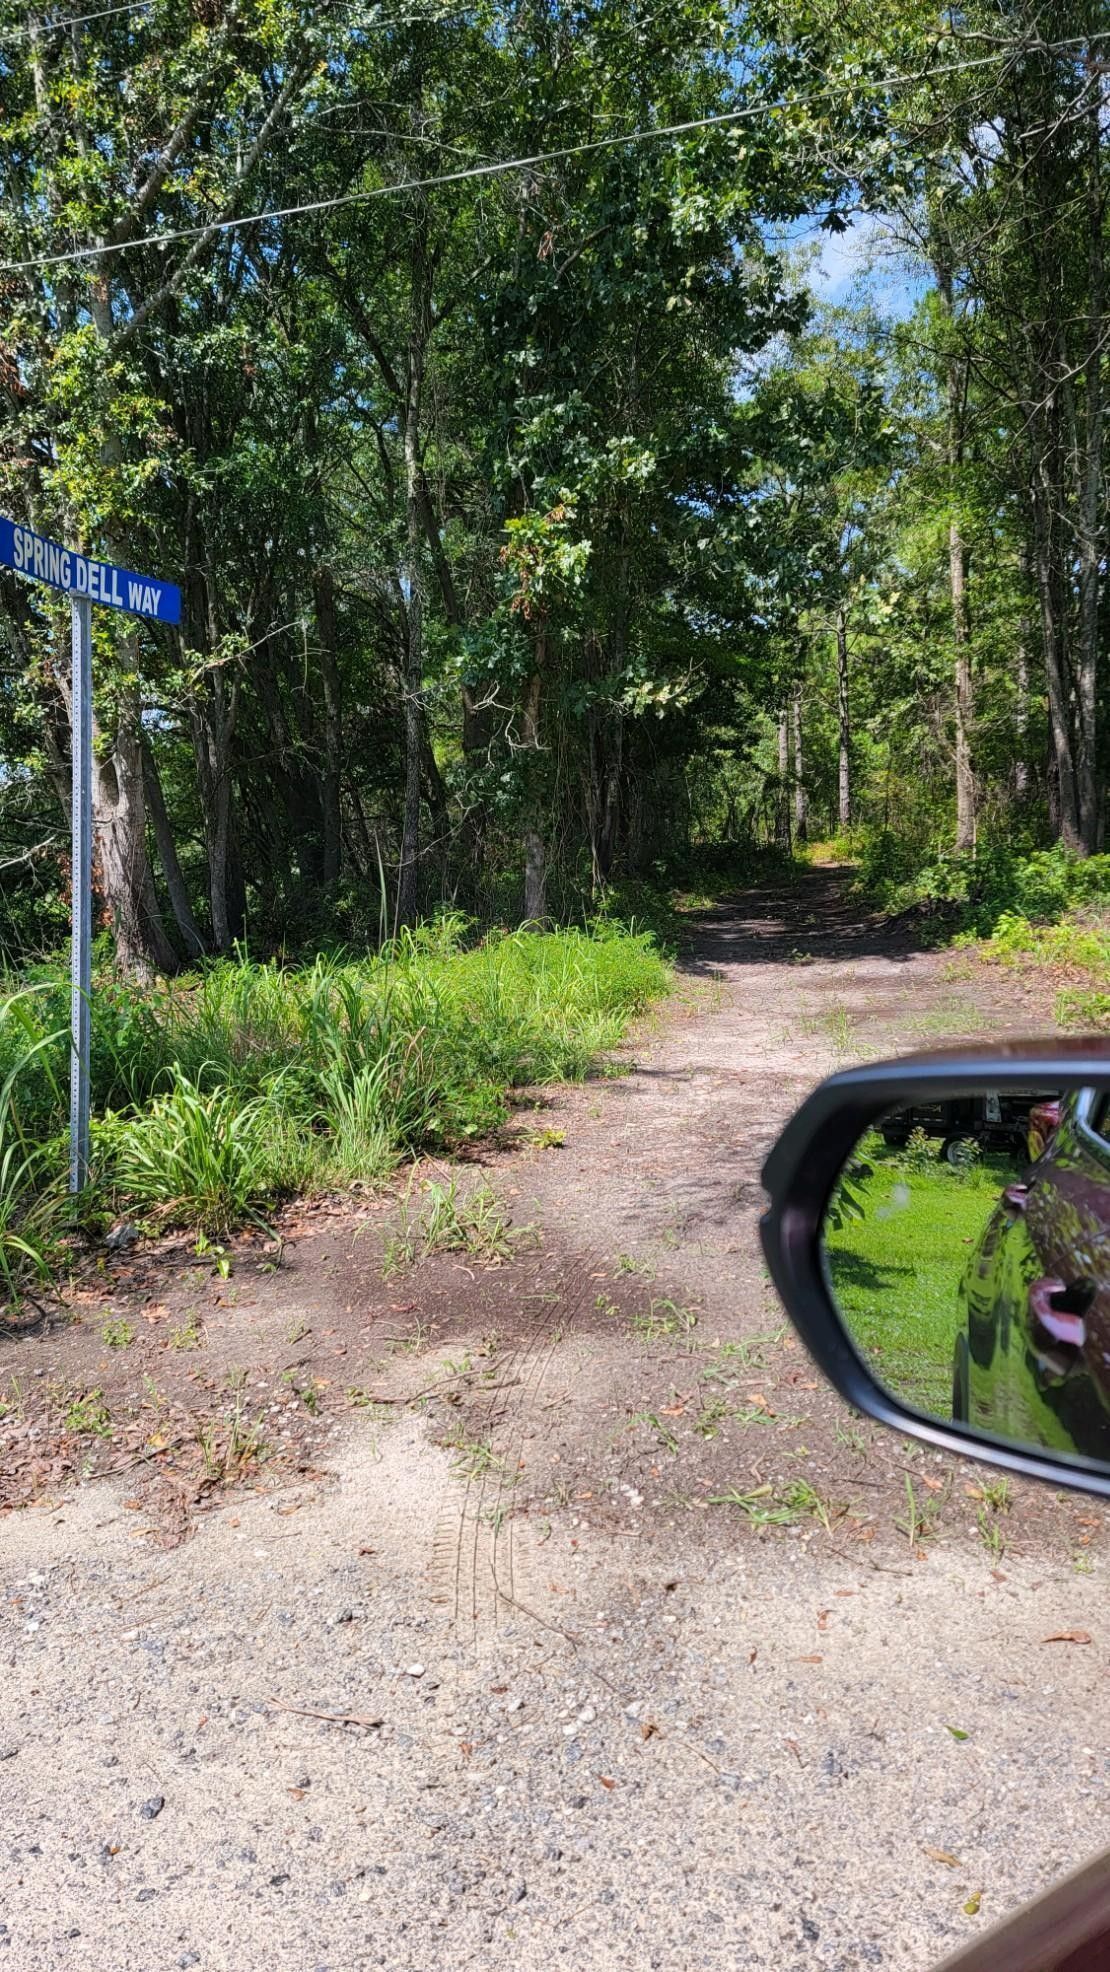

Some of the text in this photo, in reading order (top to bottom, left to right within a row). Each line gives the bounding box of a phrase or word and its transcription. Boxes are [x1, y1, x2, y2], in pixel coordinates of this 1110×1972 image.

[13, 527, 161, 615] SPRING DELL WAY
